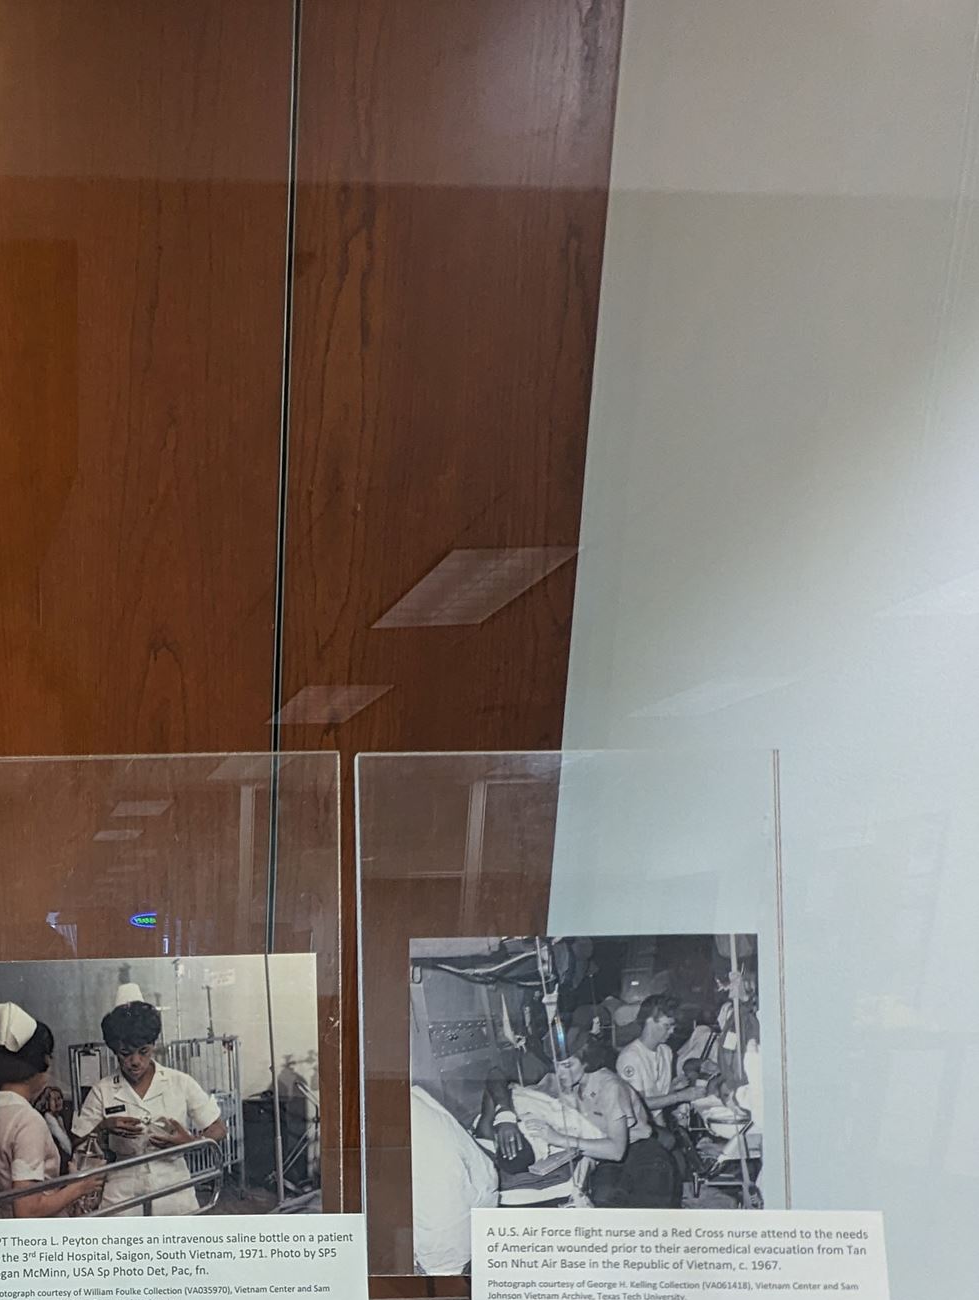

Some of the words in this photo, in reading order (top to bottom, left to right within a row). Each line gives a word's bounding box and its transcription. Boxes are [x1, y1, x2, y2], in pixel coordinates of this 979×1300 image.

[10, 1236, 47, 1246] Theora
[51, 1236, 58, 1245] L.
[62, 1236, 98, 1247] Peyton
[101, 1235, 143, 1246] changes
[146, 1236, 159, 1244] an
[162, 1234, 223, 1244] intravenous
[226, 1233, 256, 1243] saline
[259, 1232, 289, 1242] bottle
[308, 1234, 314, 1242] a
[317, 1232, 353, 1244] patient
[1, 1252, 19, 1262] the
[39, 1251, 63, 1261] Field
[67, 1251, 112, 1263] Hospital,
[116, 1251, 153, 1262] Saigon,
[156, 1250, 186, 1260] South
[189, 1249, 235, 1260] Vietnam,
[239, 1249, 267, 1258] 1971.
[270, 1248, 300, 1258] Photo
[303, 1248, 316, 1259] by
[318, 1248, 336, 1257] SP5
[487, 1242, 499, 1252] of
[501, 1242, 553, 1252] American
[556, 1243, 608, 1252] wounded
[611, 1243, 637, 1255] prior
[640, 1244, 652, 1253] to
[654, 1243, 680, 1253] their
[683, 1244, 750, 1254] aeromedical
[753, 1244, 813, 1254] evacuation
[817, 1244, 843, 1254] from
[846, 1245, 866, 1255] Tan
[561, 1292, 595, 1300] Archive,
[597, 1292, 620, 1300] Texas
[621, 1292, 642, 1300] Tech
